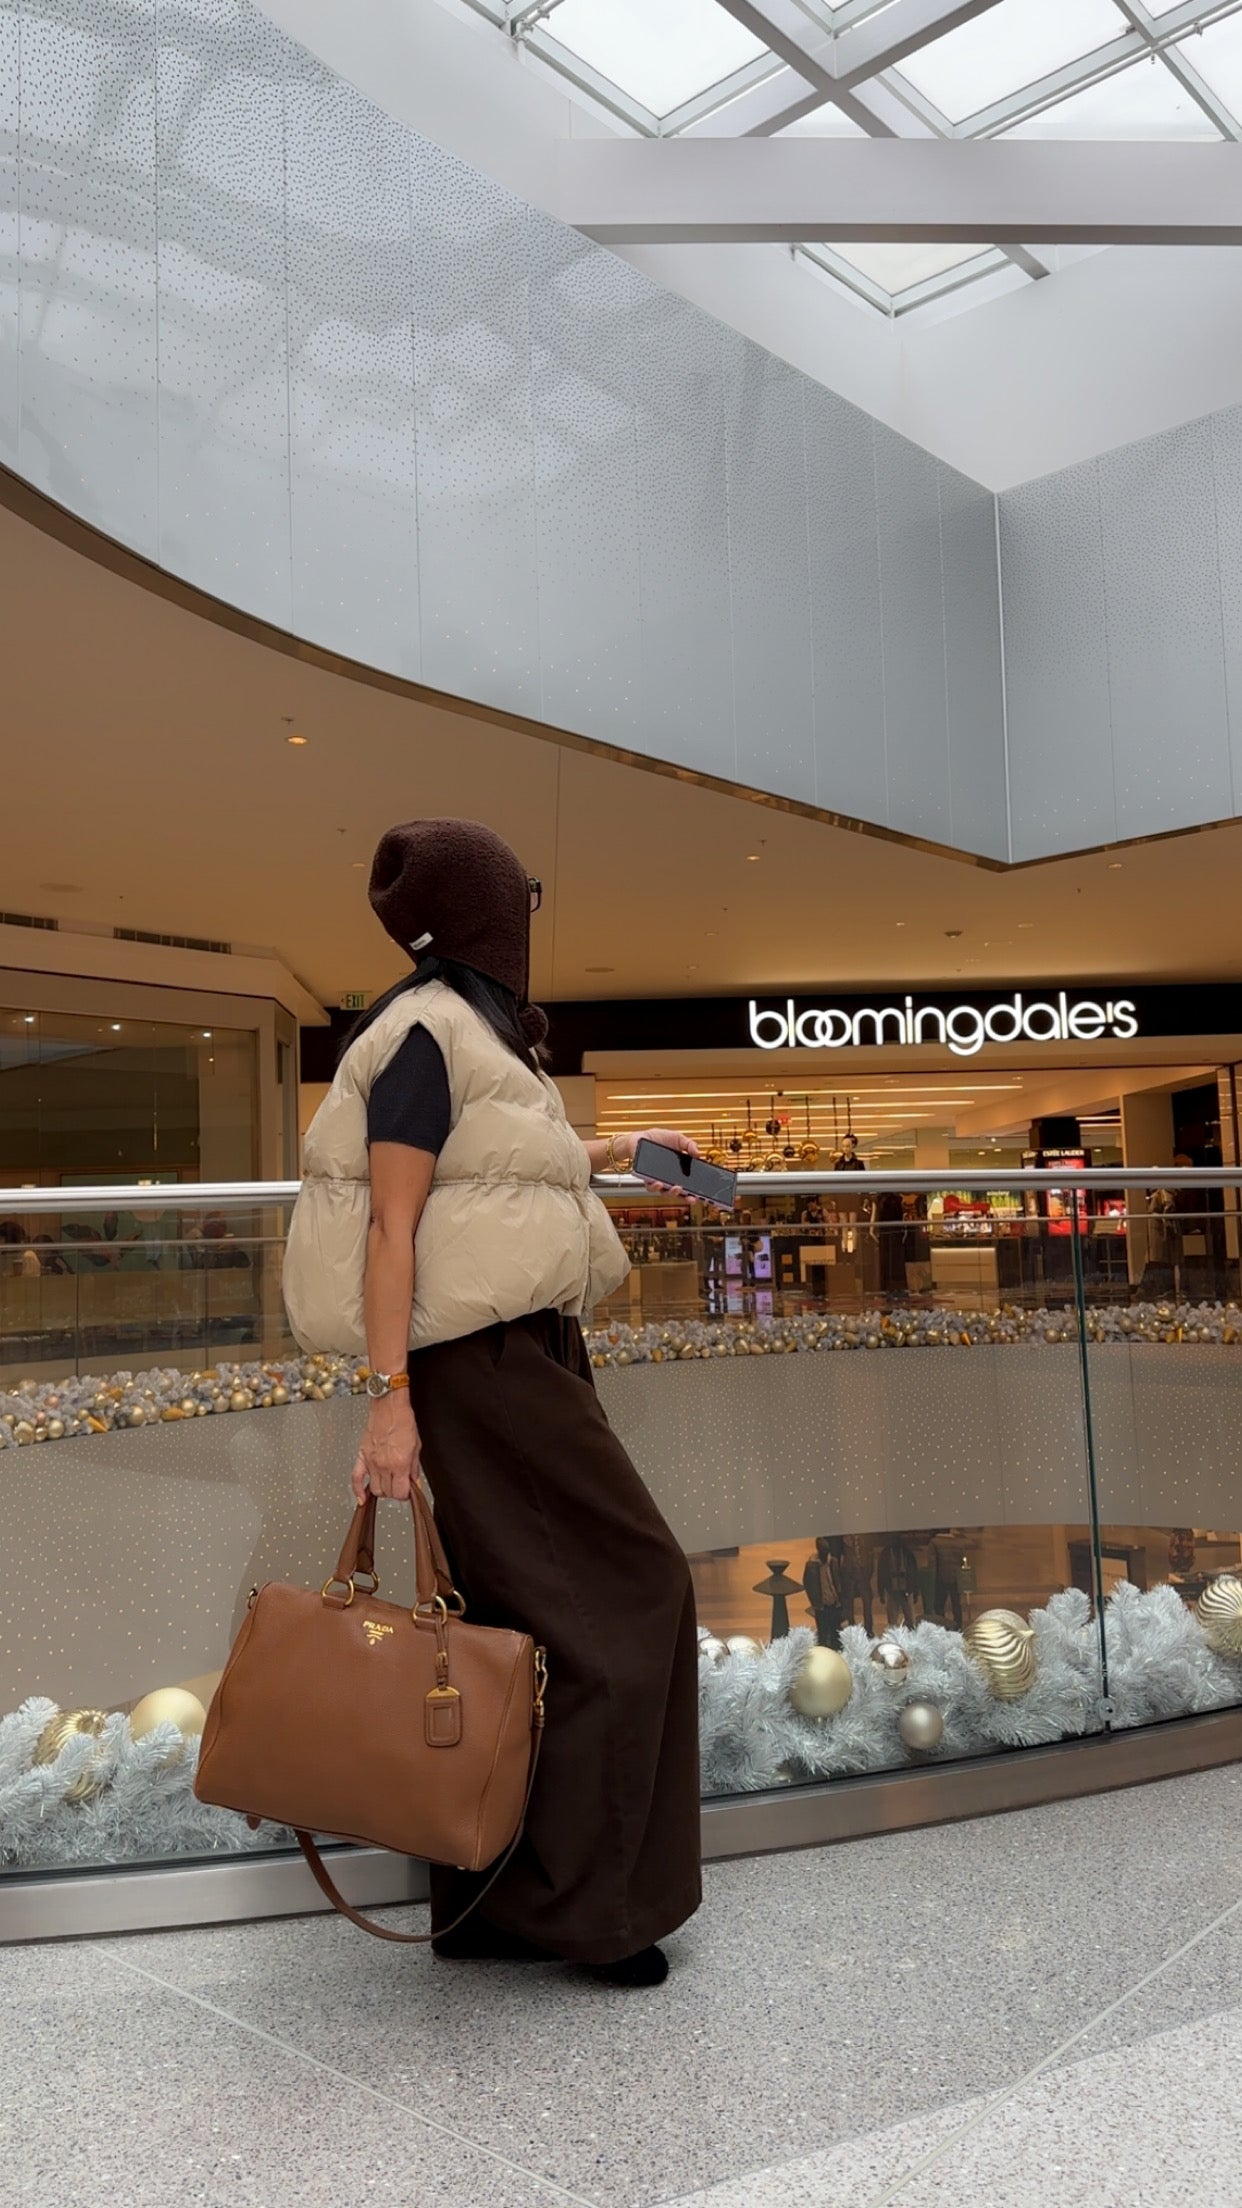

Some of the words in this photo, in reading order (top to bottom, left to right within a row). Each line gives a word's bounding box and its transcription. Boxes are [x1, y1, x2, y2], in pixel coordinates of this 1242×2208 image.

[346, 994, 364, 1008] EXIT
[749, 991, 1138, 1056] bloomingdale's
[362, 1620, 394, 1634] PRADA
